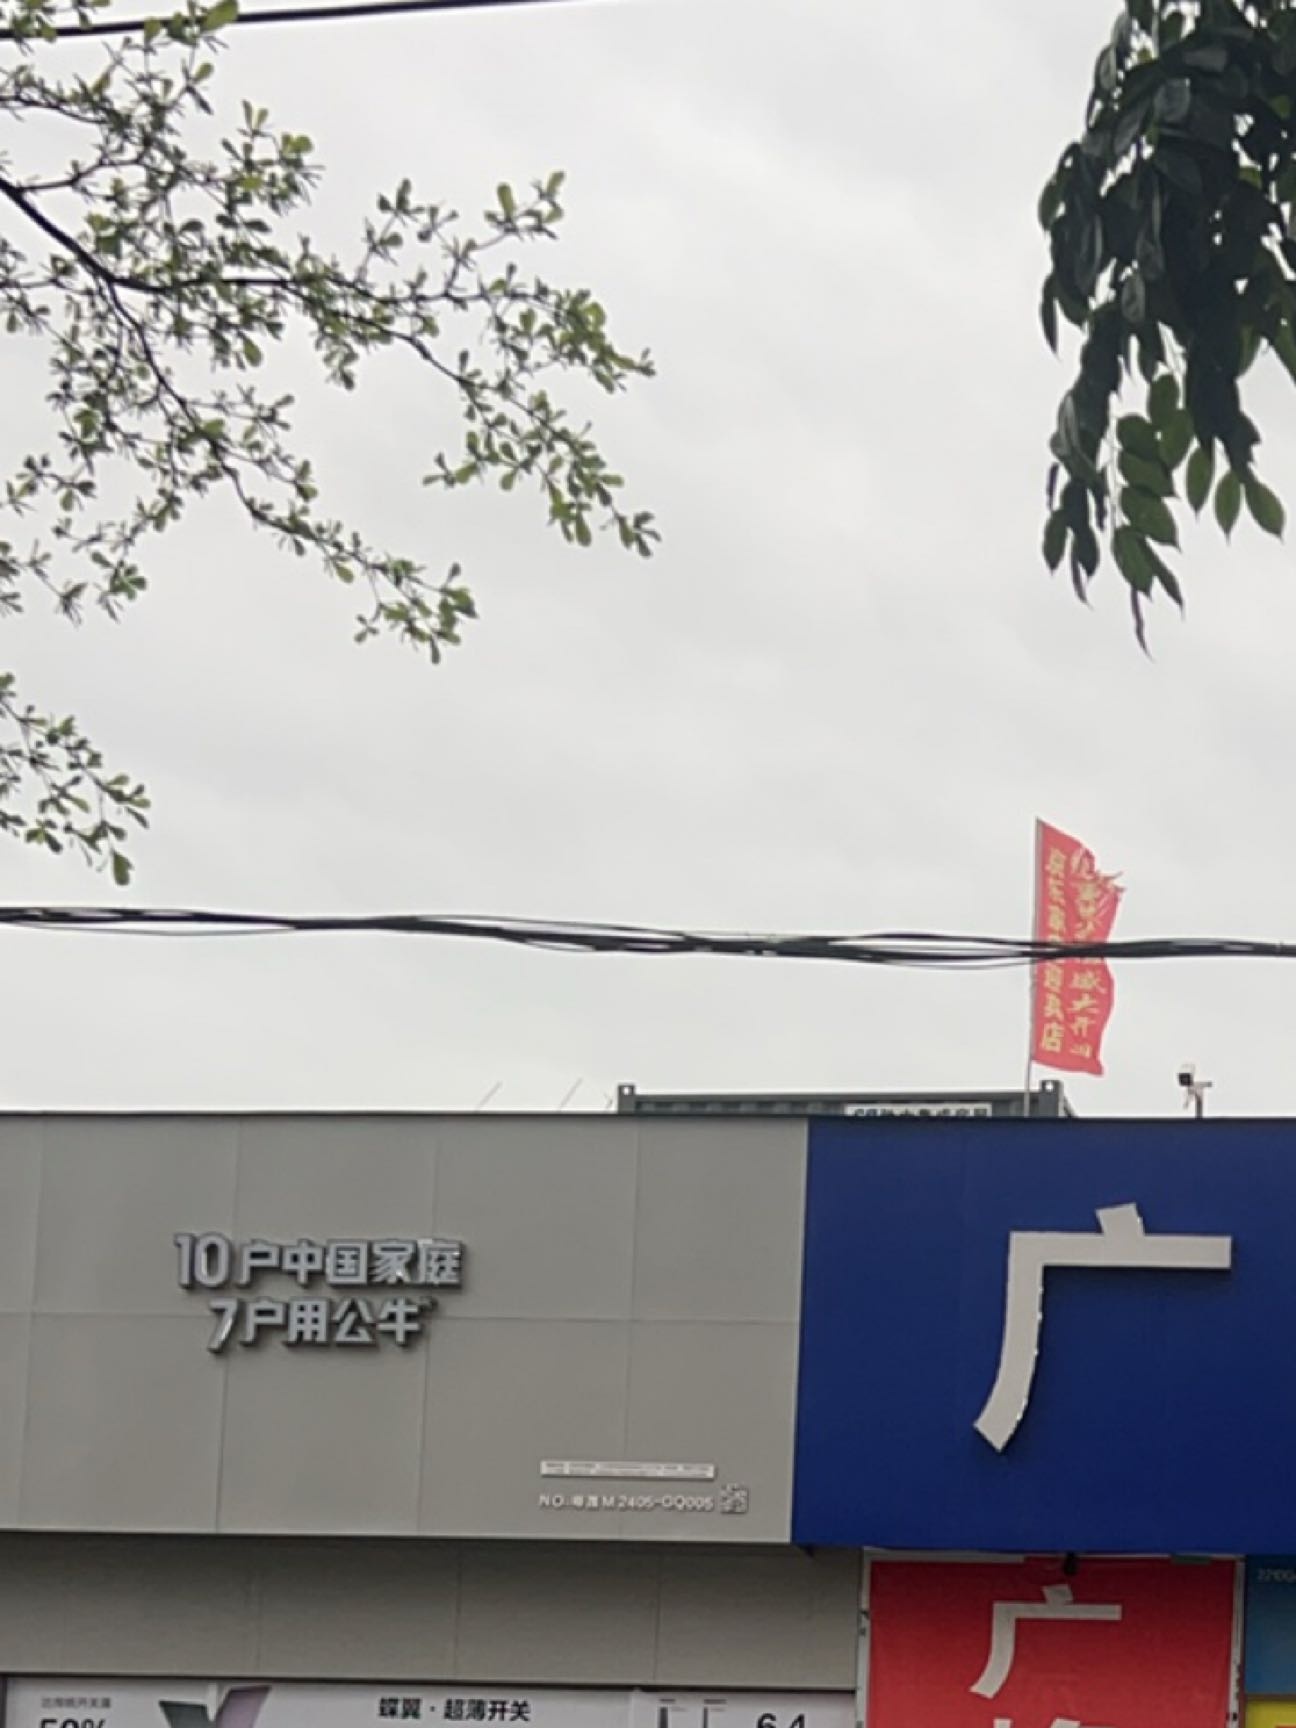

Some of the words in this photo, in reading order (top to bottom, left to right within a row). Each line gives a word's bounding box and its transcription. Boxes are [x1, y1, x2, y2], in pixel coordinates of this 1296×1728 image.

[173, 1231, 462, 1288] 10户中国家庭
[206, 1297, 421, 1353] 7户用公牛
